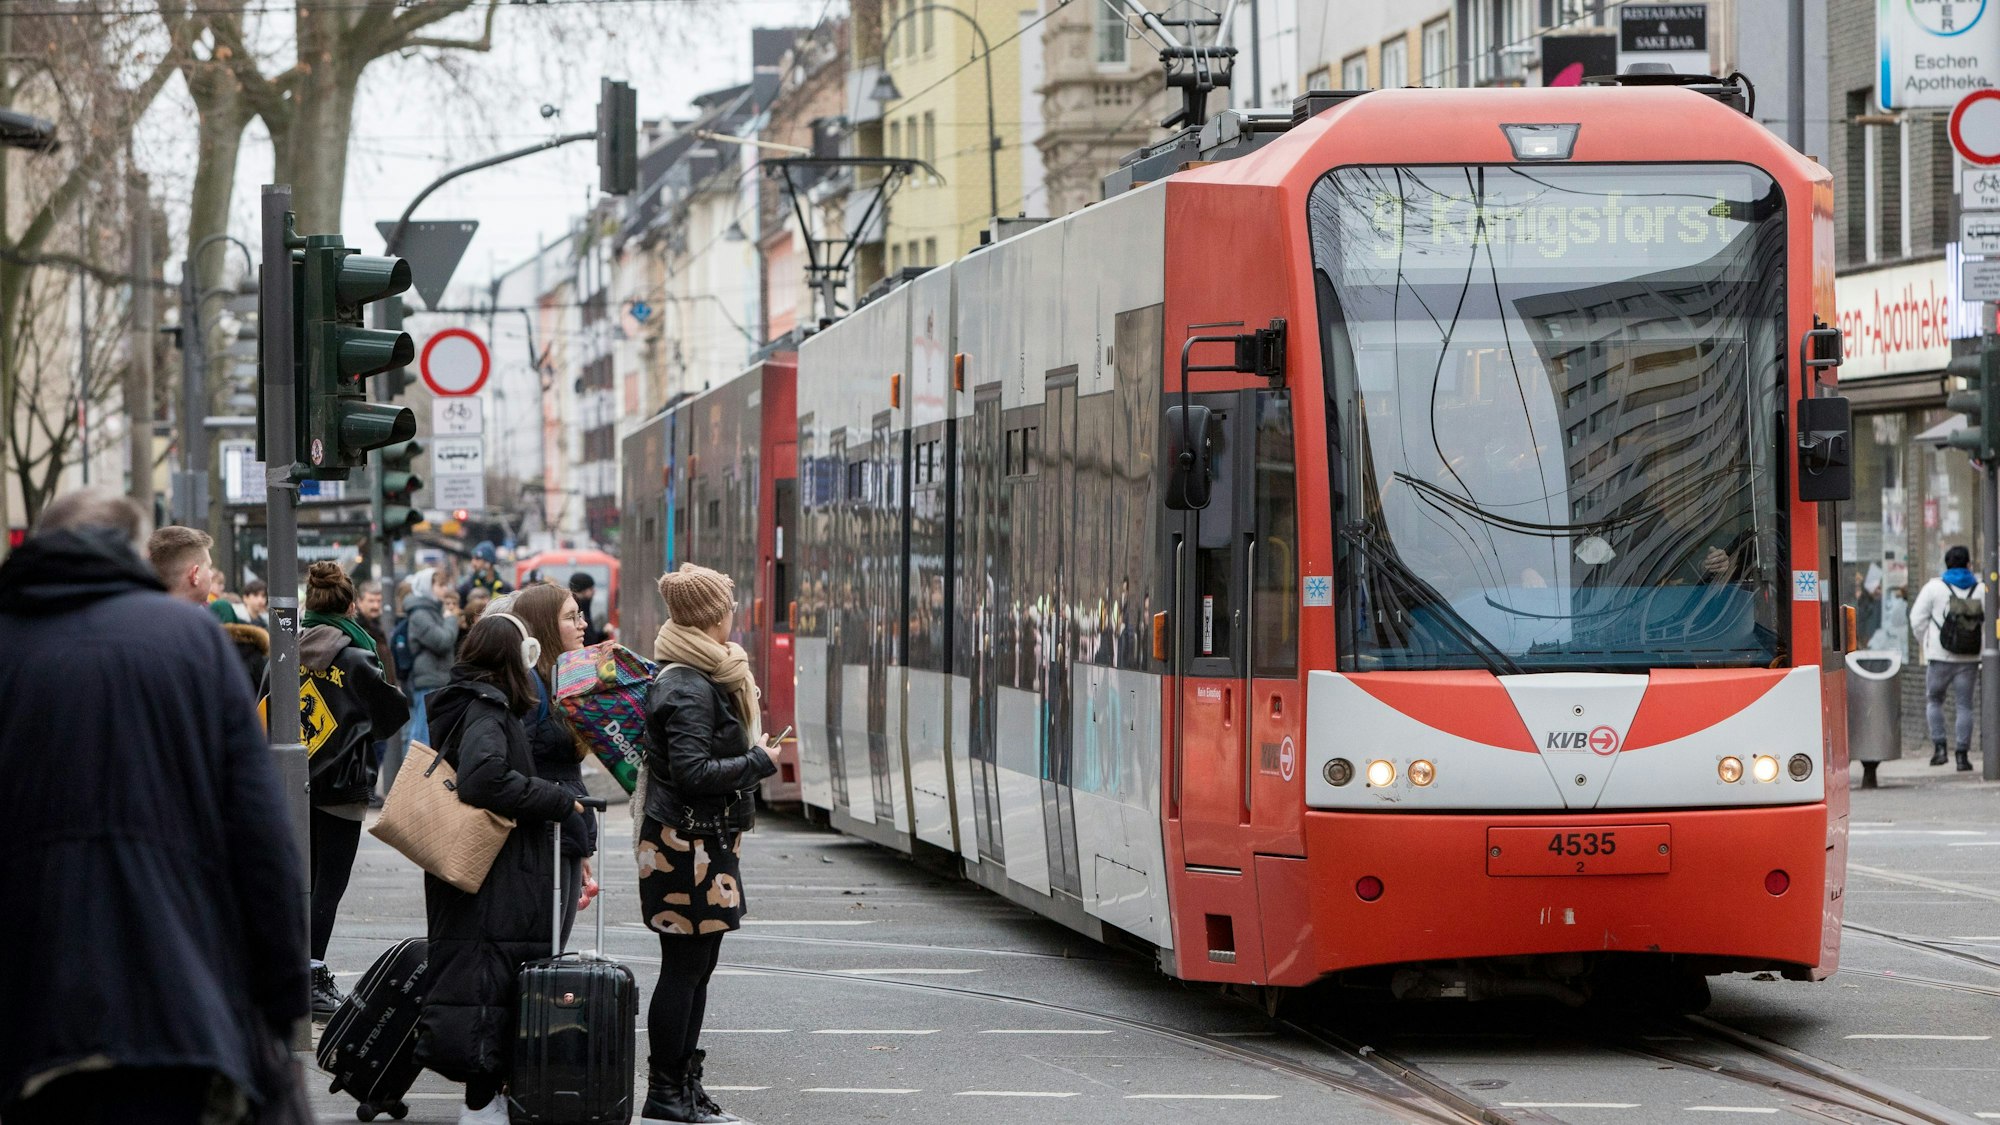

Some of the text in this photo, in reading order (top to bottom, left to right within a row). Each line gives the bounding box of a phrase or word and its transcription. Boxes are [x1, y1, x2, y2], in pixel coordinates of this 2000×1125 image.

[1622, 7, 1703, 19] RESTAURANT
[1635, 35, 1695, 49] SAKE BAR
[1914, 54, 1978, 69] Eschen
[1905, 75, 1987, 94] Apotheke
[1981, 195, 1999, 204] frei
[1981, 240, 1999, 250] frei
[1836, 279, 1948, 371] en-Apotheke
[1546, 732, 1588, 749] KVB
[1548, 832, 1616, 856] 4535
[1576, 861, 1585, 873] 2
[356, 1005, 397, 1060] TRAVELLER
